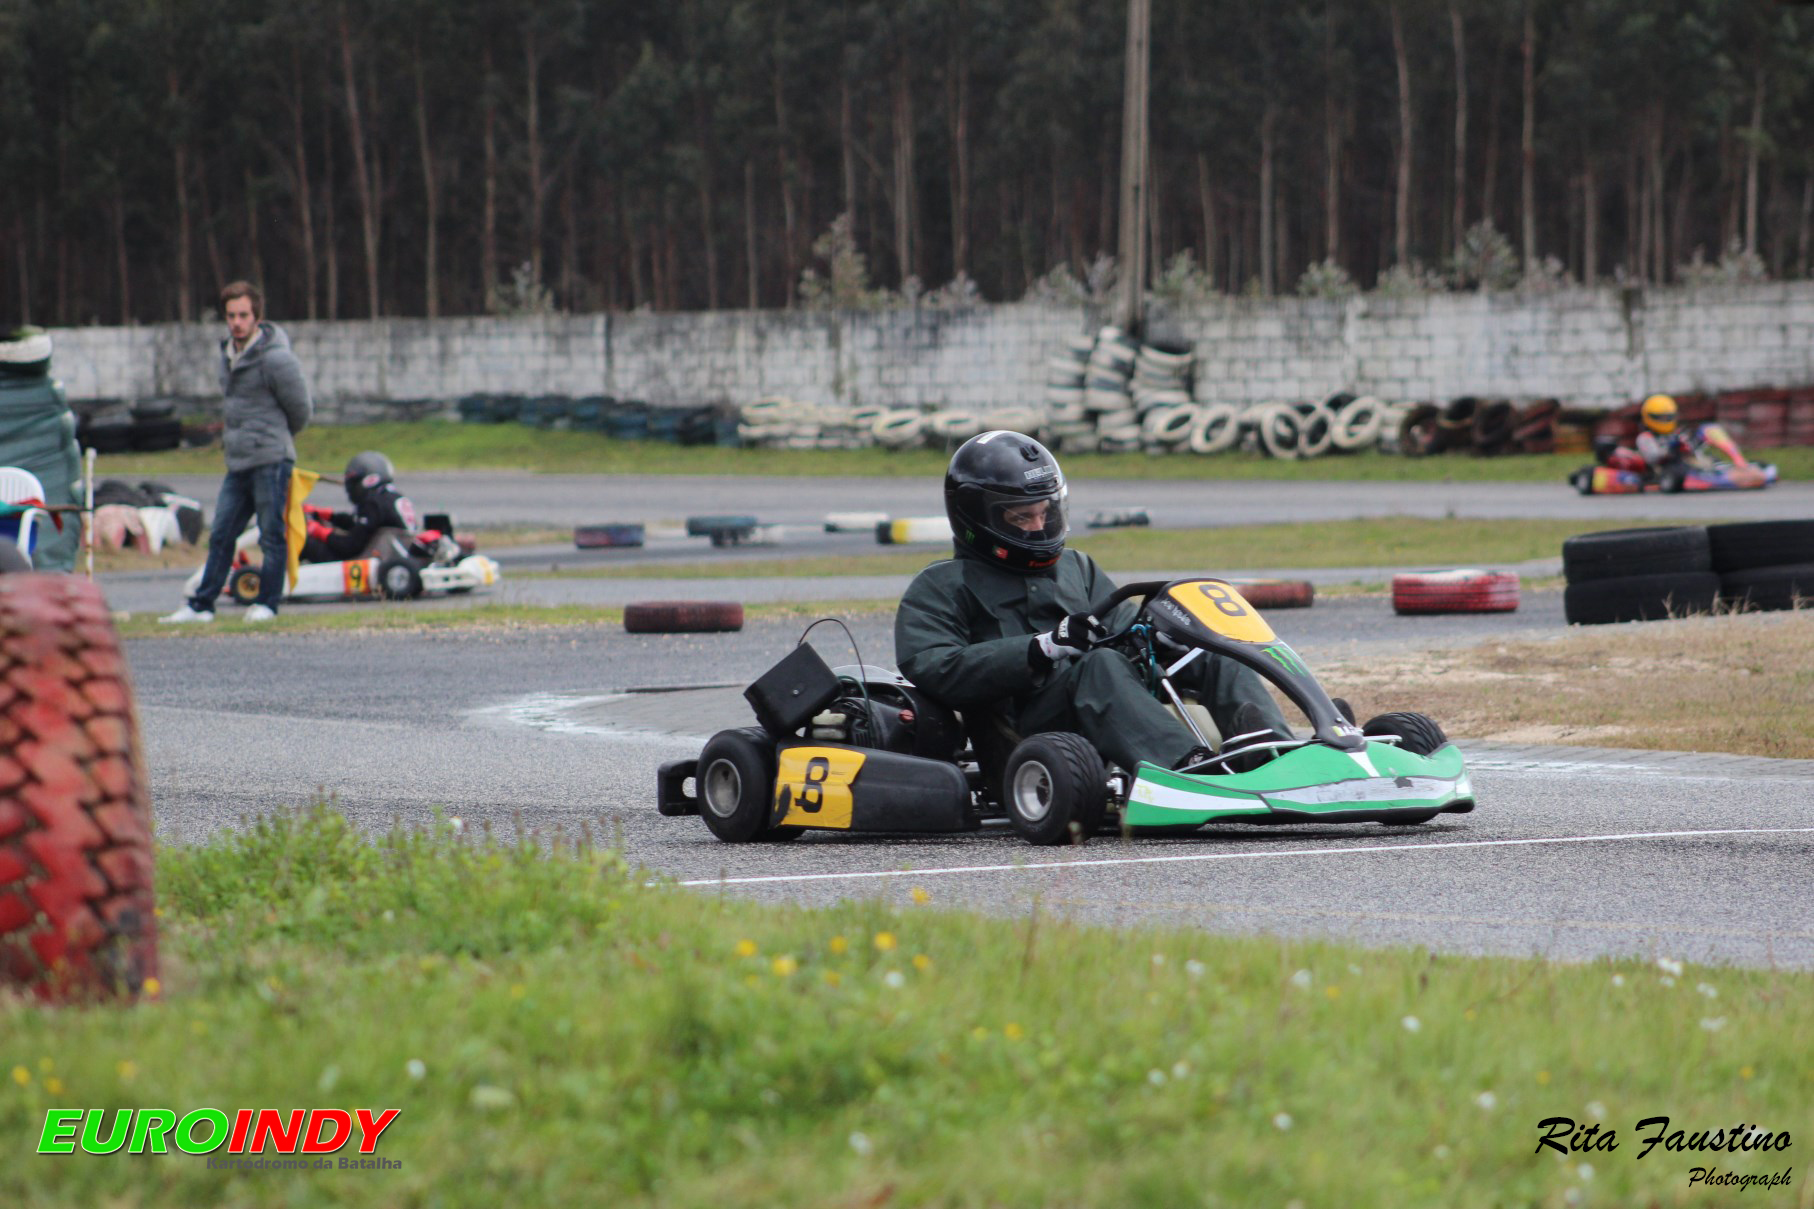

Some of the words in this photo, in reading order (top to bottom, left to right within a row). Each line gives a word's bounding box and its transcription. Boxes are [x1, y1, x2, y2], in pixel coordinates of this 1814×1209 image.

[350, 564, 362, 588] 9
[1199, 584, 1248, 617] 8
[797, 756, 830, 814] 8
